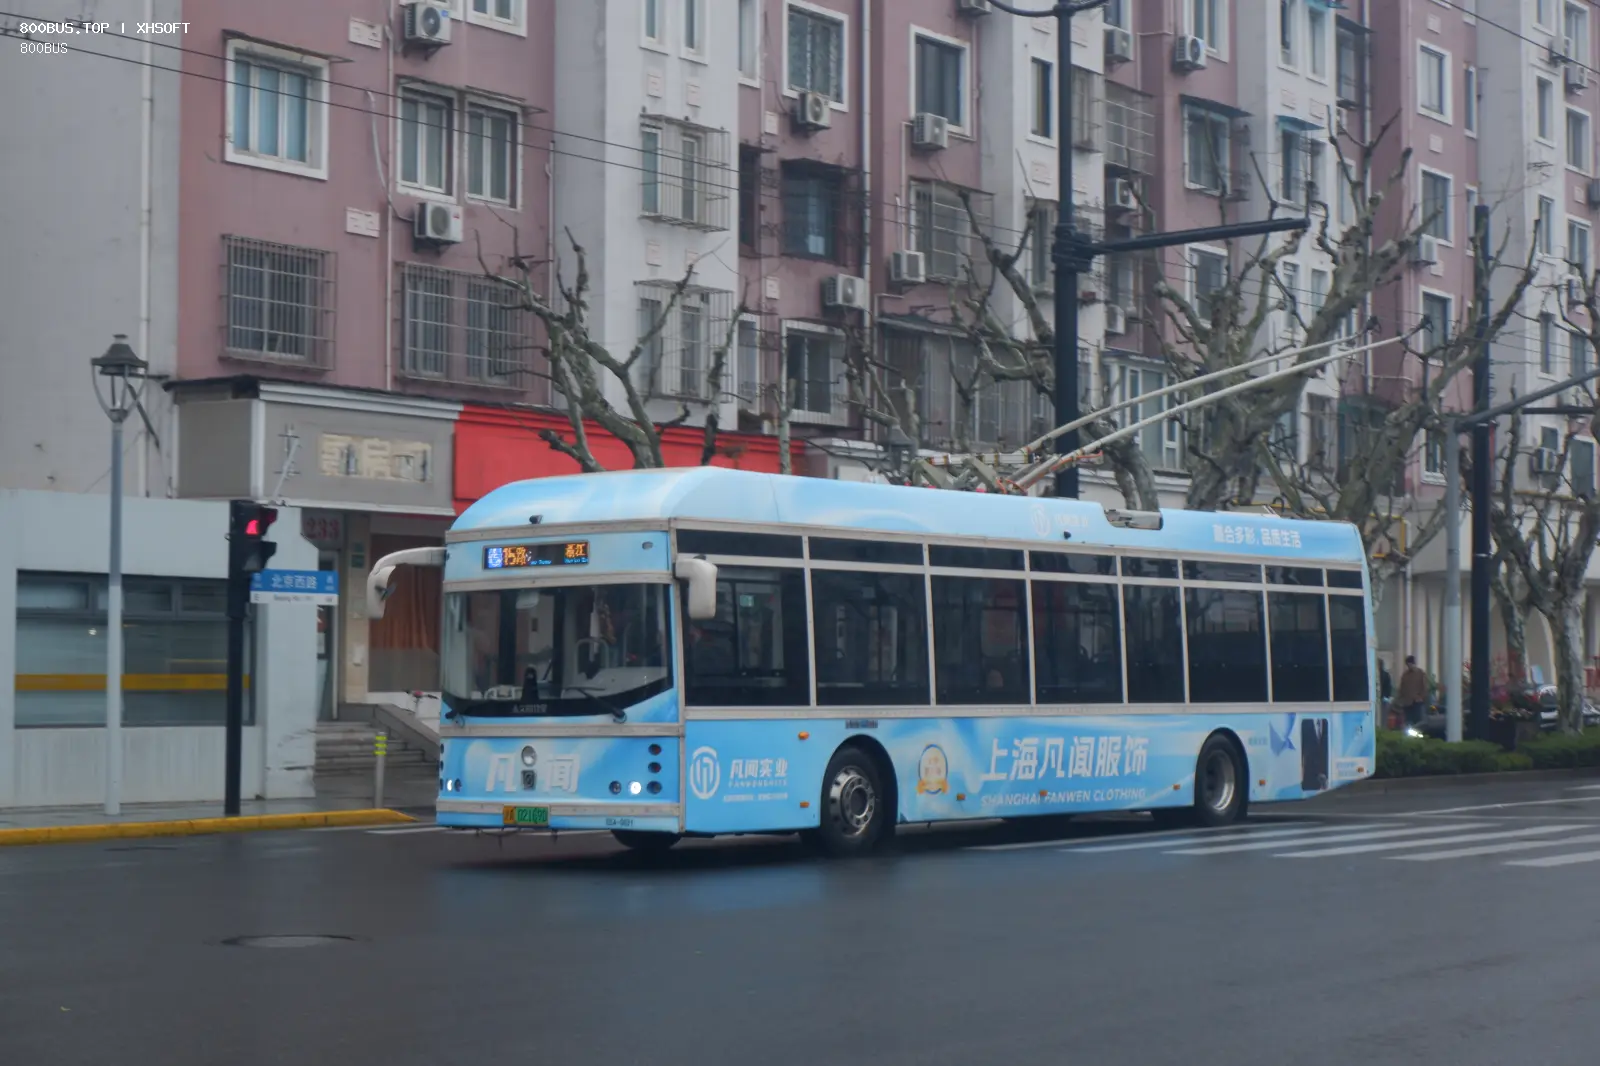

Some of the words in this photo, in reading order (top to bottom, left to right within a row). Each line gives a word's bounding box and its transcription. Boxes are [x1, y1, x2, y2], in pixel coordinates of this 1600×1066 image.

[271, 573, 317, 589] 北京西路
[980, 735, 1149, 782] 上海凡闻服饰
[980, 793, 1041, 806] SHANGHAI
[1044, 791, 1090, 803] FANWEN
[1092, 787, 1146, 801] CLOTHING
